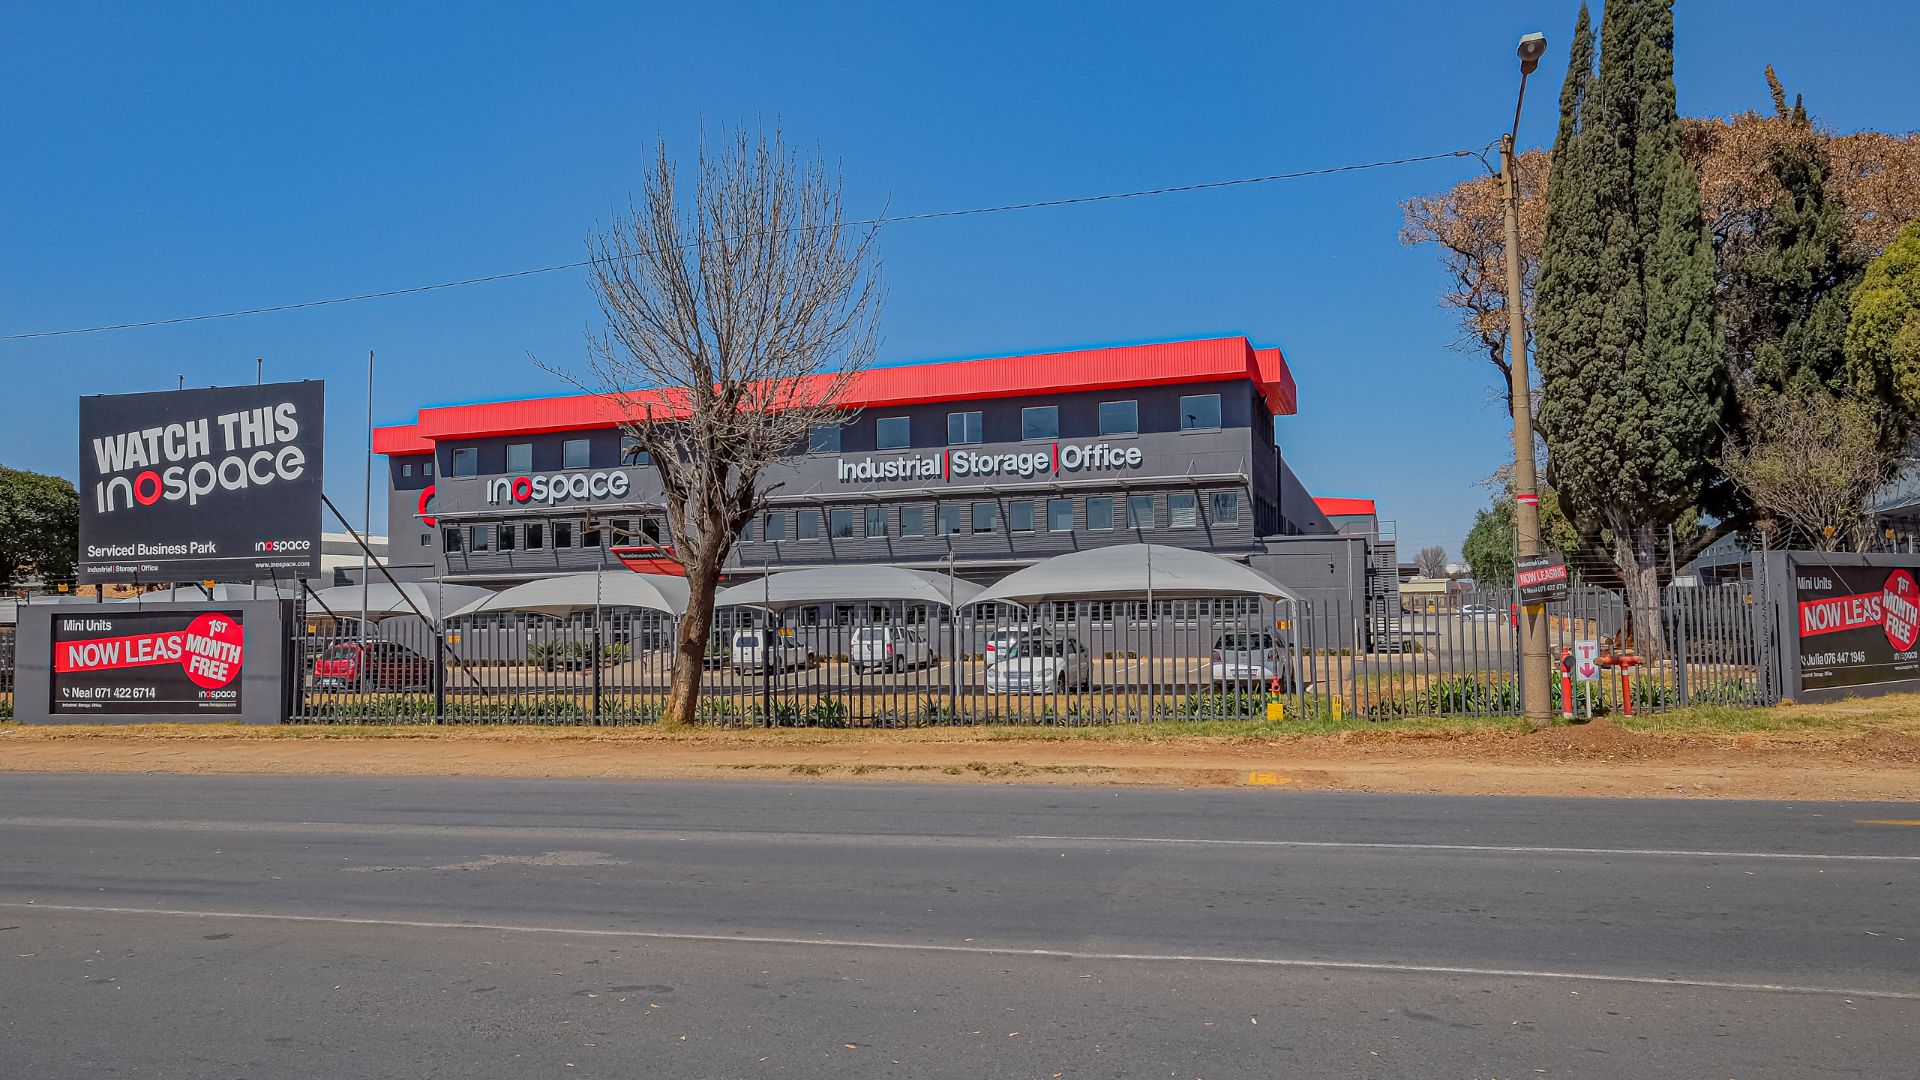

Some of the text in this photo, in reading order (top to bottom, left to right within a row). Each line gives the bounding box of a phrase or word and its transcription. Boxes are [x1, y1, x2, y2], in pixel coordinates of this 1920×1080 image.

[93, 403, 299, 474] WATCH THIS
[838, 443, 1142, 479] Industrial Storage Office
[96, 446, 305, 513] inospace
[487, 471, 630, 505] inospace
[87, 541, 216, 558] Serviced Business Park
[255, 540, 310, 553] inospace
[87, 564, 158, 573] Industrial Storage Office
[1520, 567, 1564, 584] NOW LEASING
[1797, 576, 1832, 590] Mini Units
[1897, 577, 1910, 594] 1ST
[1804, 595, 1881, 632] NOW LEAS
[1882, 588, 1918, 627] MONTH
[63, 620, 112, 632] Mini Units
[208, 619, 228, 637] 1ST
[1885, 612, 1911, 645] FREE
[69, 635, 184, 668] NOW LEAS
[185, 633, 242, 664] MONTH
[1893, 650, 1918, 660] inspace
[1806, 651, 1866, 666] Julia 076 447 1946
[189, 656, 229, 682] FREE
[71, 687, 156, 698] Neal 071 422 6714
[198, 690, 237, 699] inospace
